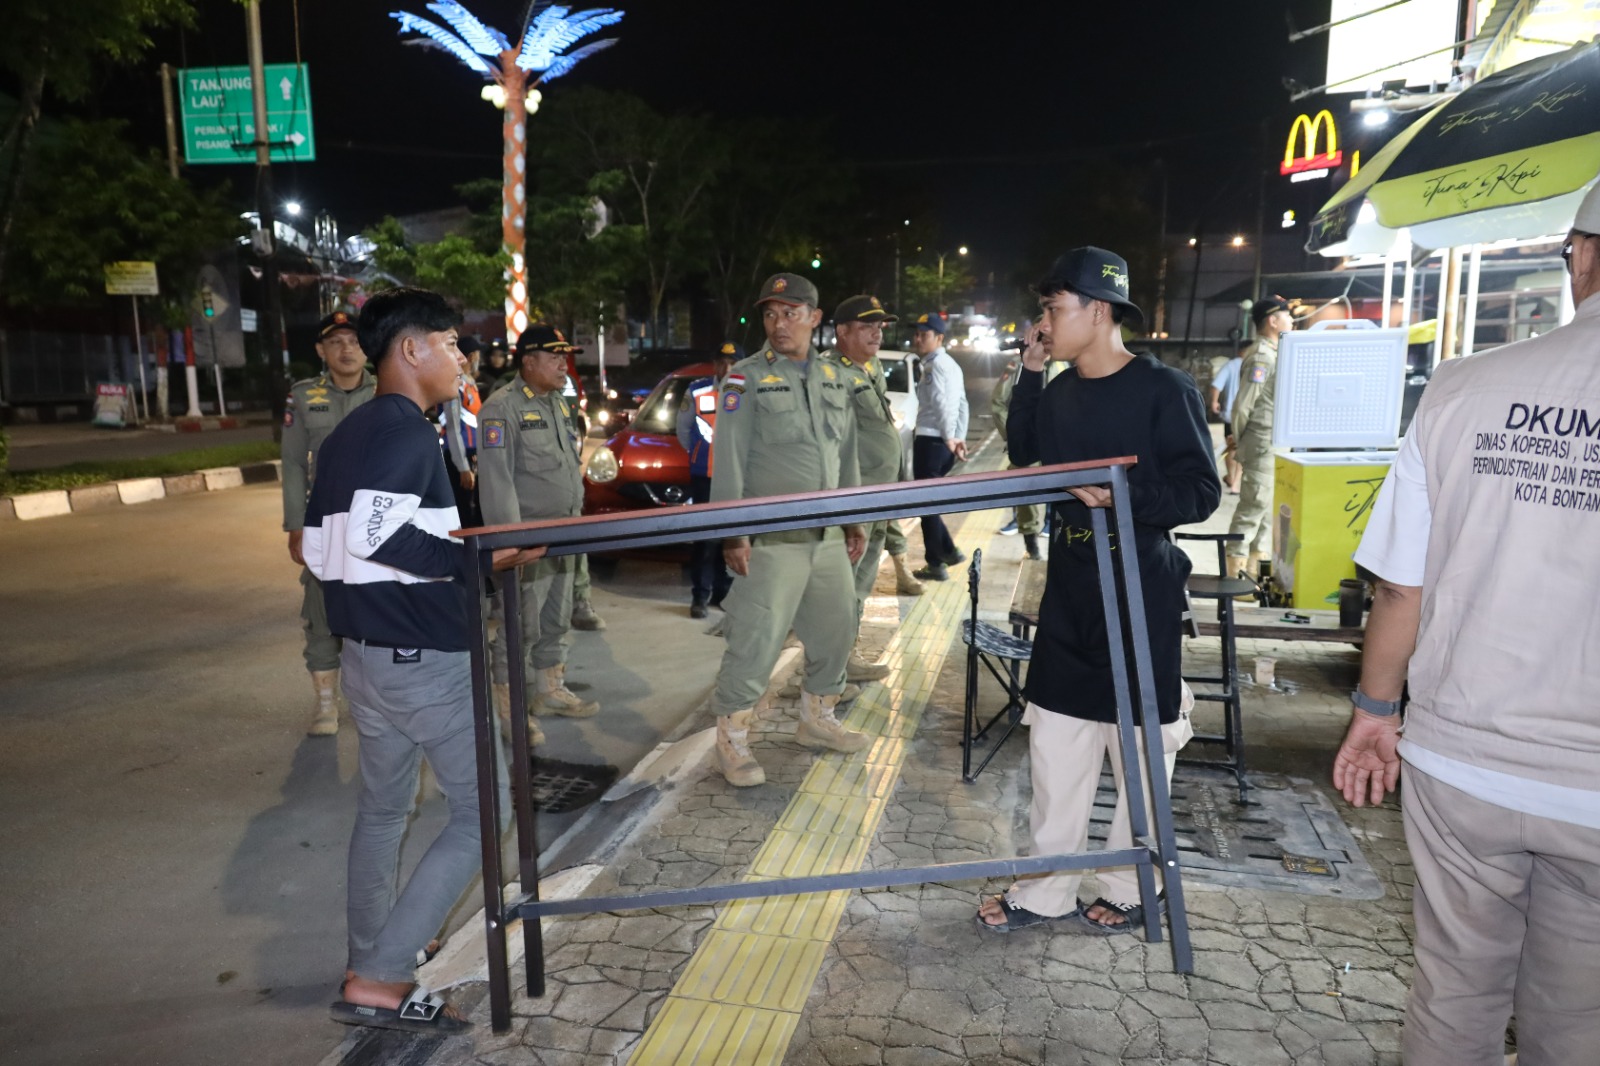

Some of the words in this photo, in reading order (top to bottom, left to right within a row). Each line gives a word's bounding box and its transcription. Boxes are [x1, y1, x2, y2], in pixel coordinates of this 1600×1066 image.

[190, 77, 252, 91] TANJUNG
[191, 95, 225, 109] LAUT
[1487, 158, 1541, 198] Kopi
[1475, 433, 1506, 451] DINAS
[1510, 434, 1570, 459] KOPERASI
[1583, 442, 1600, 464] US
[1473, 456, 1549, 481] PERINDUSTRIAN
[1550, 465, 1577, 486] DAN
[372, 495, 394, 509] 63
[1514, 482, 1547, 504] KOTA
